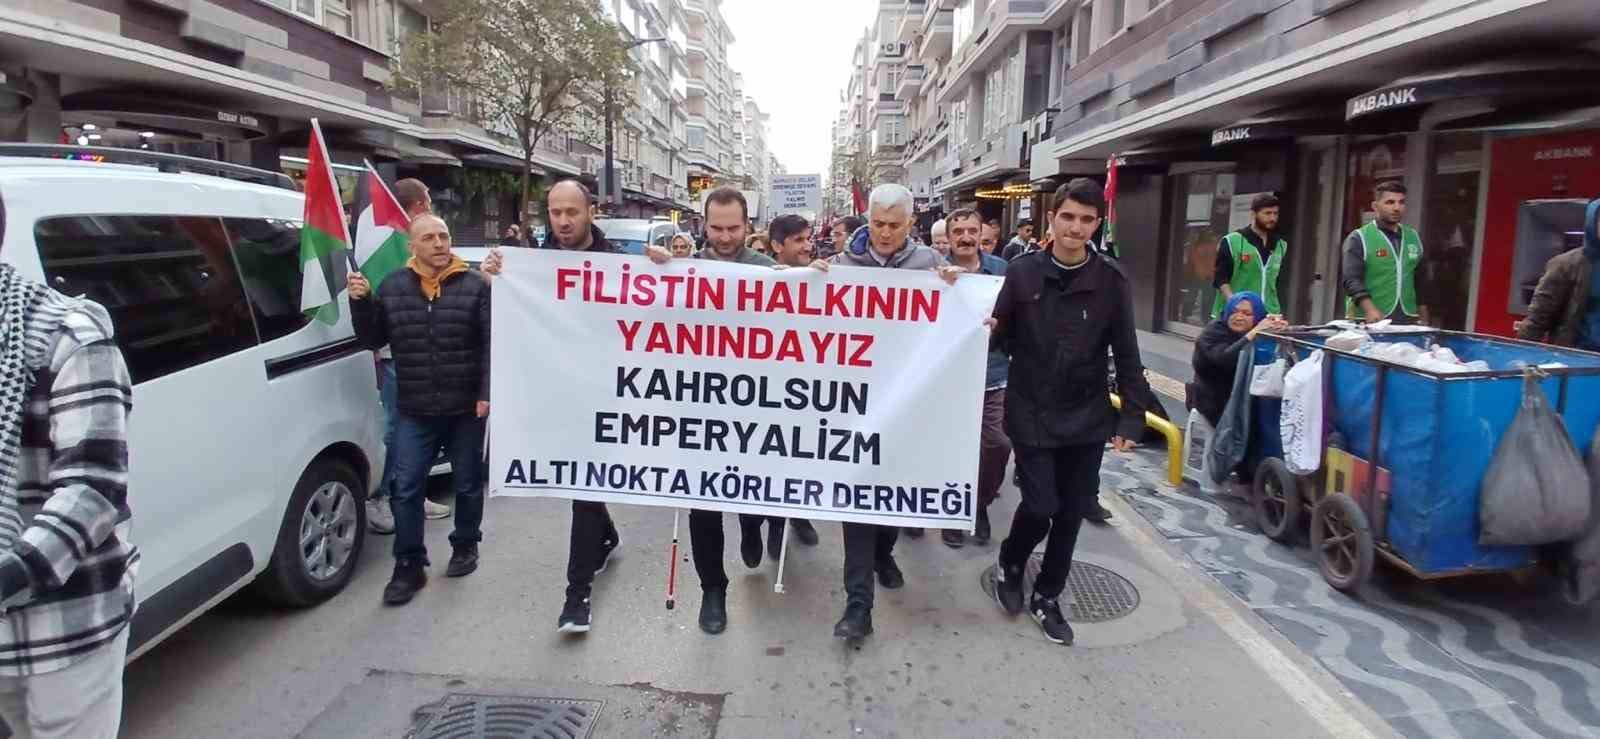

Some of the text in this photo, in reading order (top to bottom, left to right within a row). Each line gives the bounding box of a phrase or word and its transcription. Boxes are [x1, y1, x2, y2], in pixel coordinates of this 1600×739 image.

[1352, 87, 1417, 116] AKBANK
[556, 262, 942, 323] FİLİSTİN HALKININ
[616, 319, 875, 368] YANINDAYIZ
[616, 366, 869, 416] KAHROLSUN
[594, 411, 881, 466] EMPERYALİZM
[504, 459, 972, 517] ALTI NOKTA KÖRLER DERNEĞİ
